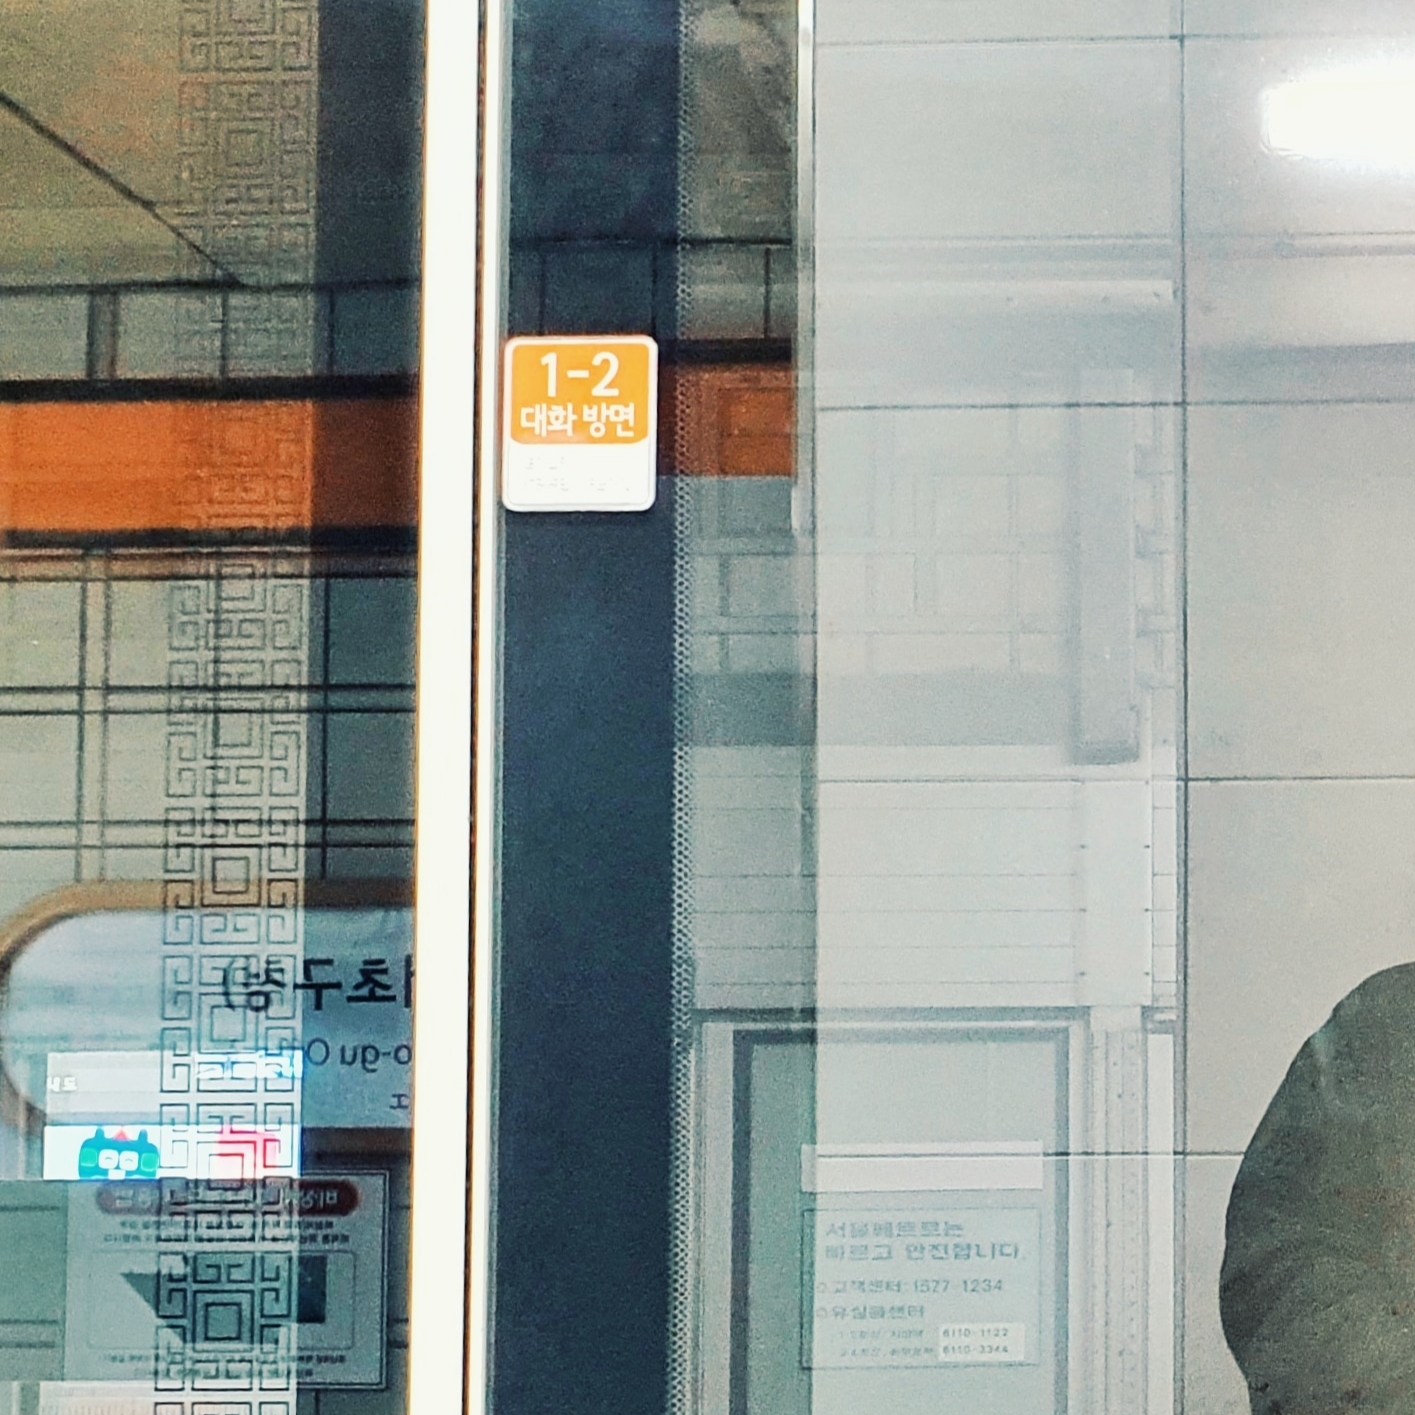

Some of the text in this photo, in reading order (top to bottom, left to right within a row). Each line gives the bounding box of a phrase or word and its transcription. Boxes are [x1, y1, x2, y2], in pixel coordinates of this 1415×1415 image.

[540, 351, 620, 398] 1-2
[520, 402, 635, 438] 대화 방면
